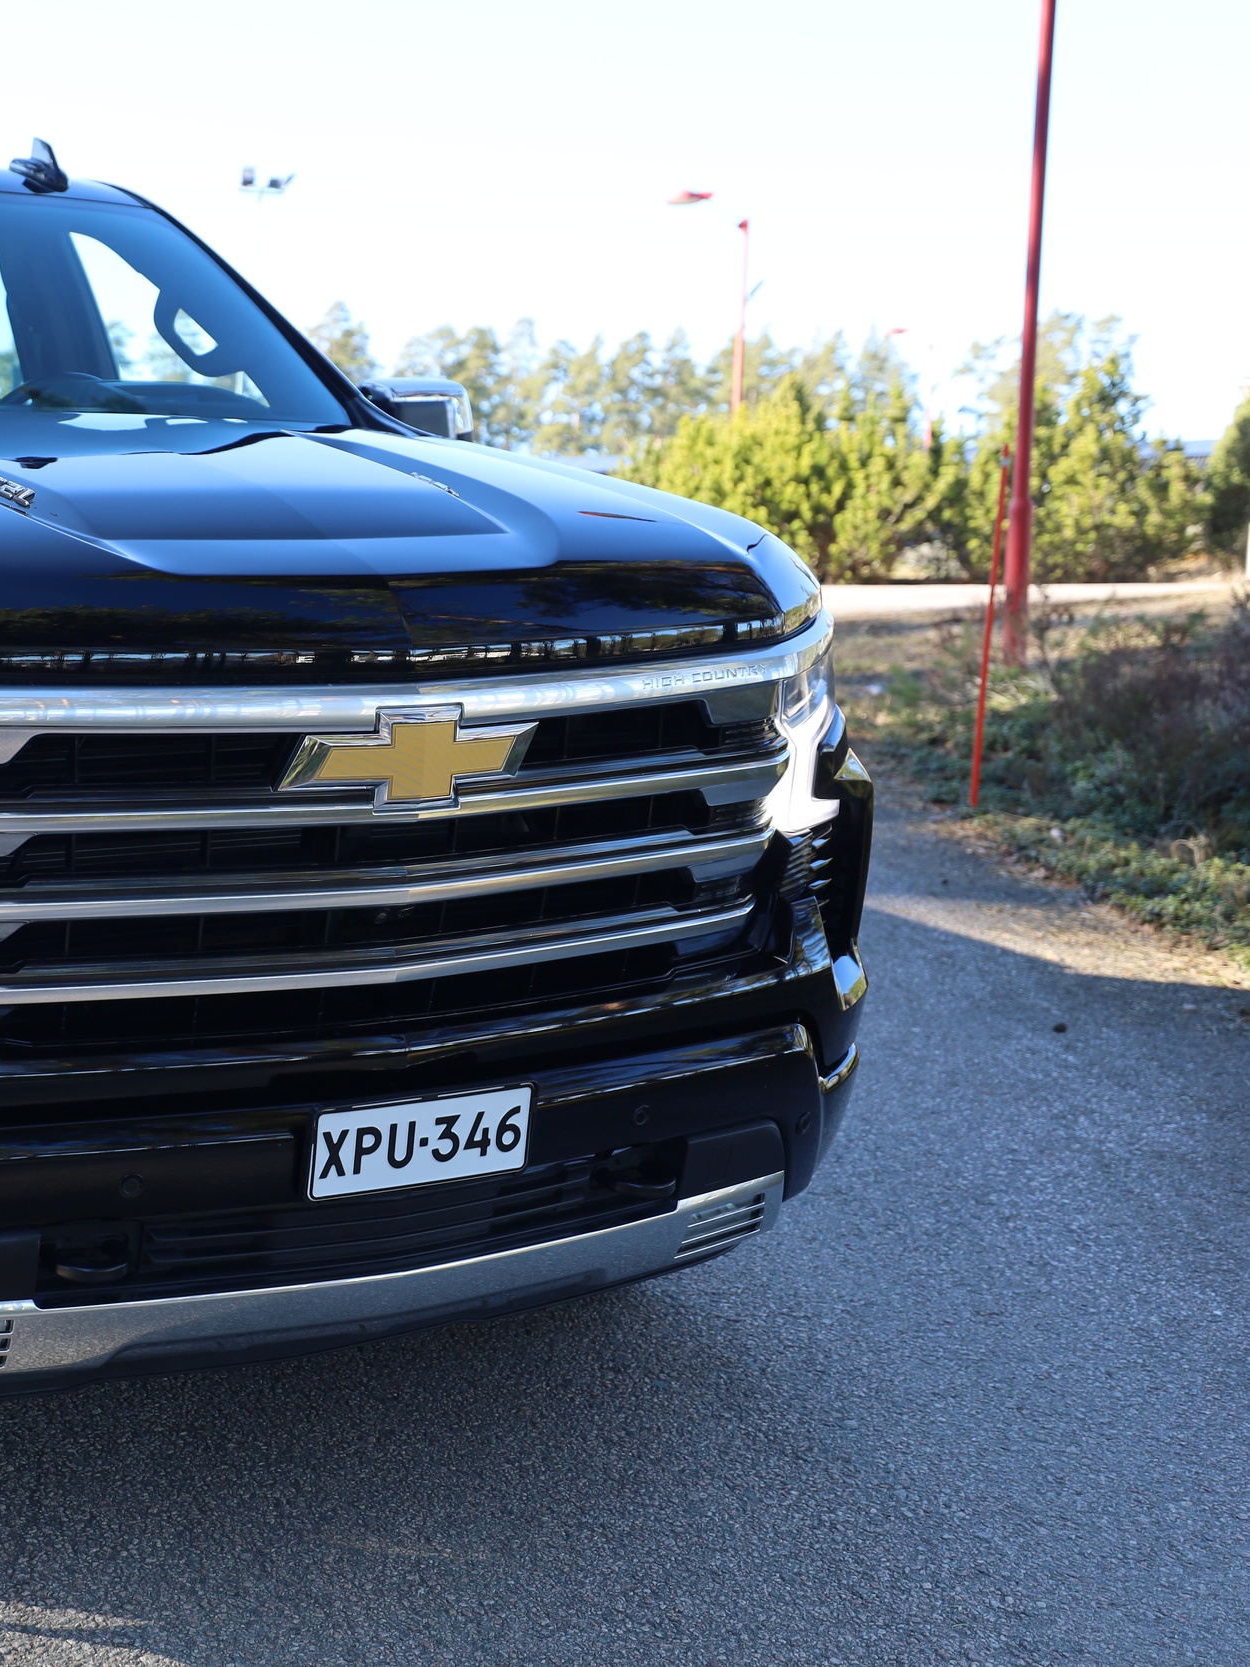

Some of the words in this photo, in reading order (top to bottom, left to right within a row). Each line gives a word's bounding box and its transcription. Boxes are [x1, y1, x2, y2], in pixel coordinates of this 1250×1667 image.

[642, 674, 685, 689] HIGH
[691, 664, 767, 682] COUNTRY
[318, 1105, 522, 1180] XPU-346
